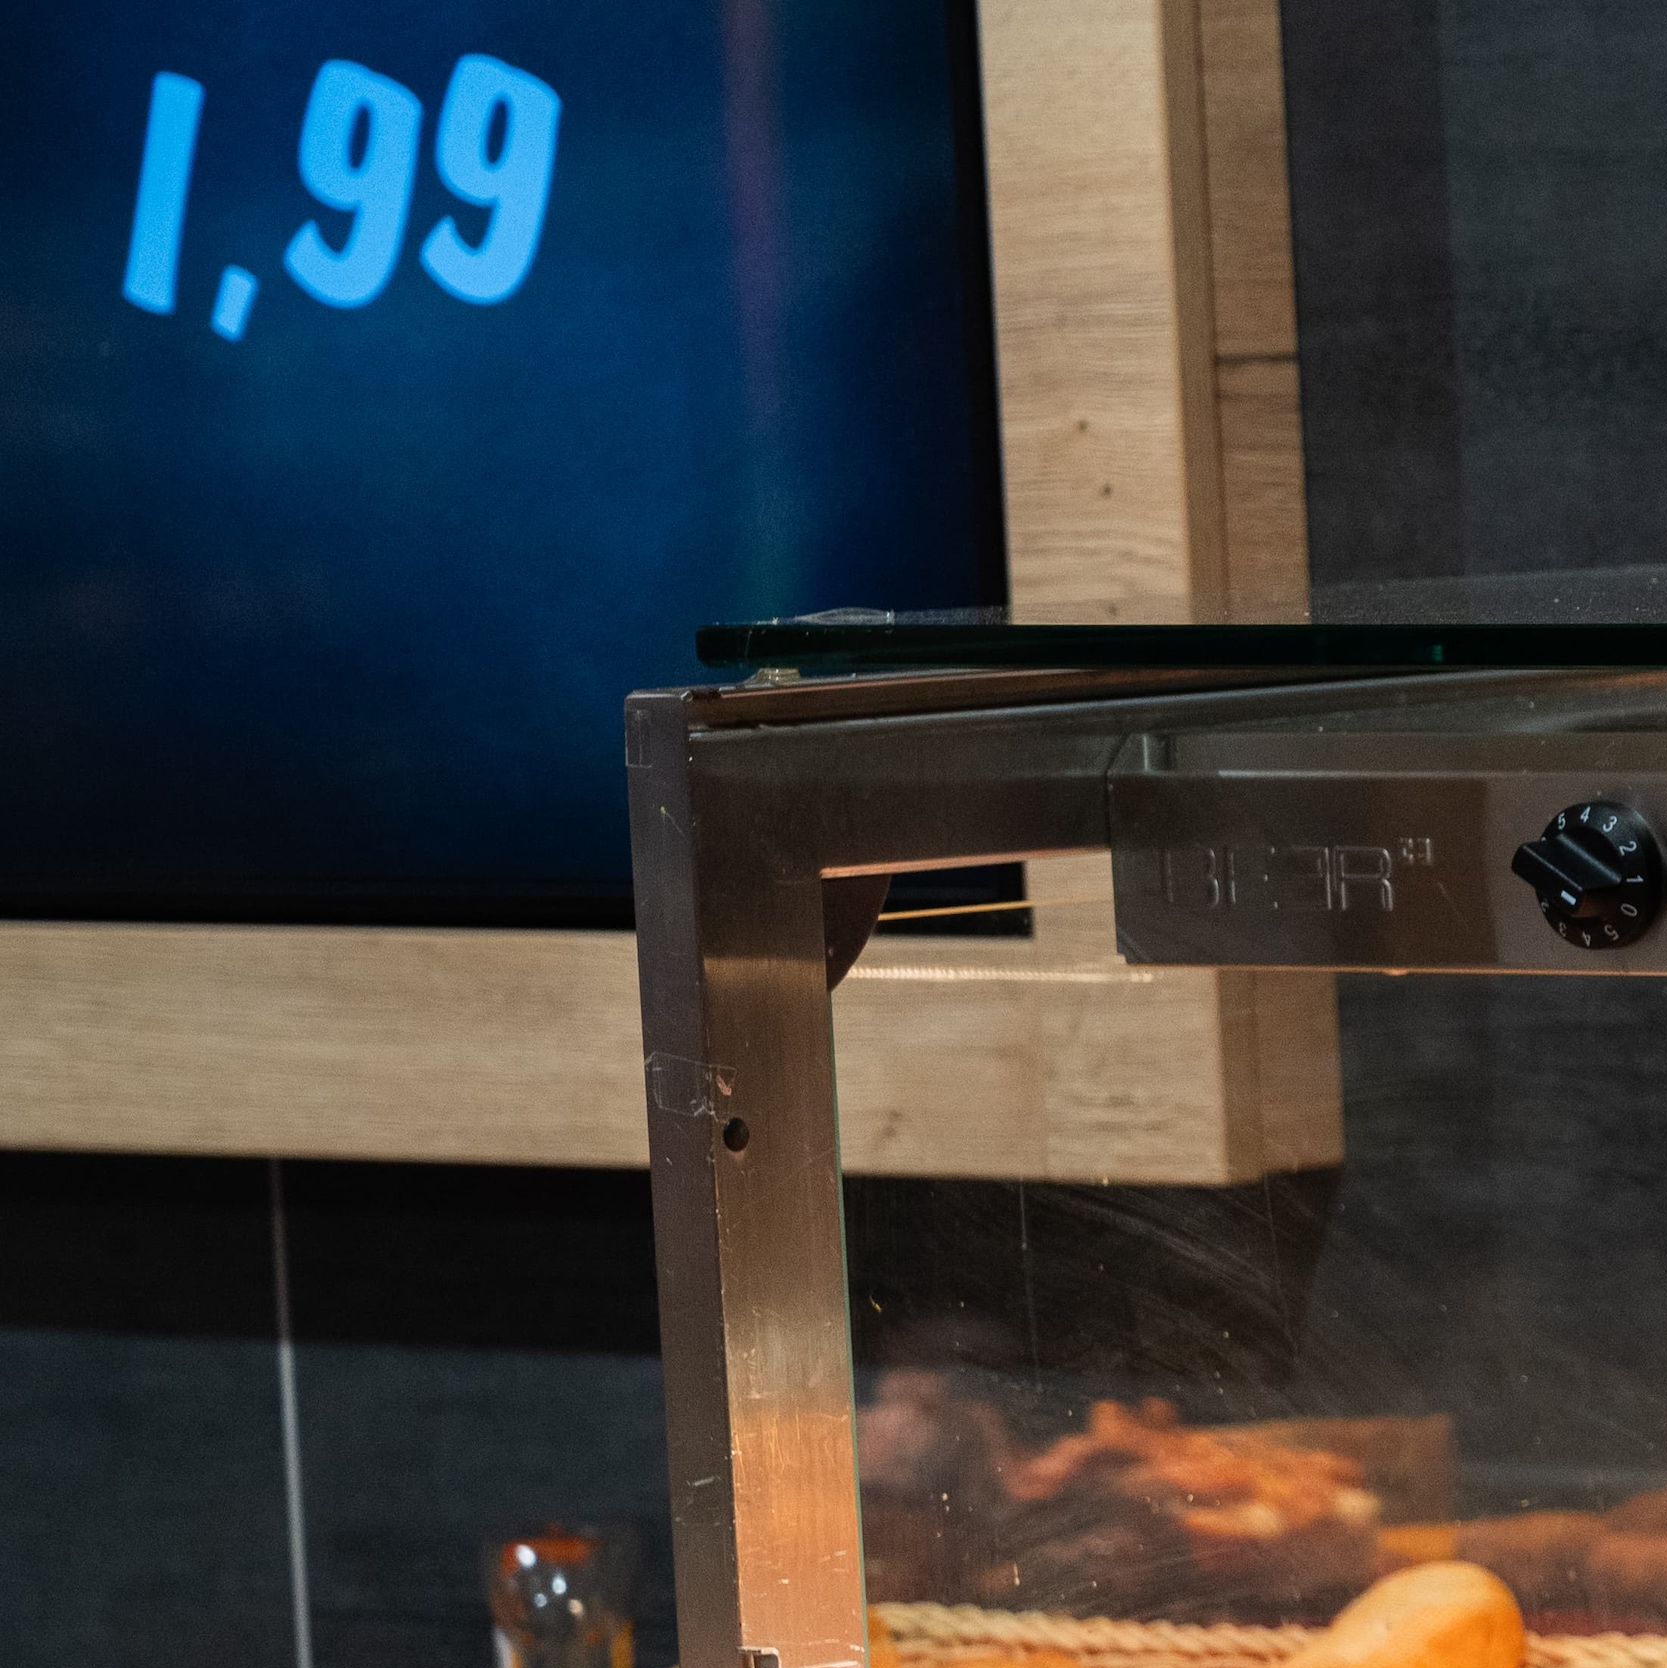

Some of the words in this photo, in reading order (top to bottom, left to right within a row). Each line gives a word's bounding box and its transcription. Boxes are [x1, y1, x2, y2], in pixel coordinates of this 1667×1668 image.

[122, 53, 562, 342] 1,99
[1558, 813, 1566, 830] 5
[1580, 806, 1590, 823] 4
[1603, 816, 1617, 832] 3
[1619, 841, 1637, 856] 2
[1626, 875, 1644, 883] 1
[1620, 903, 1638, 917] 0
[1582, 931, 1591, 947] 4
[1604, 925, 1619, 941] 5
